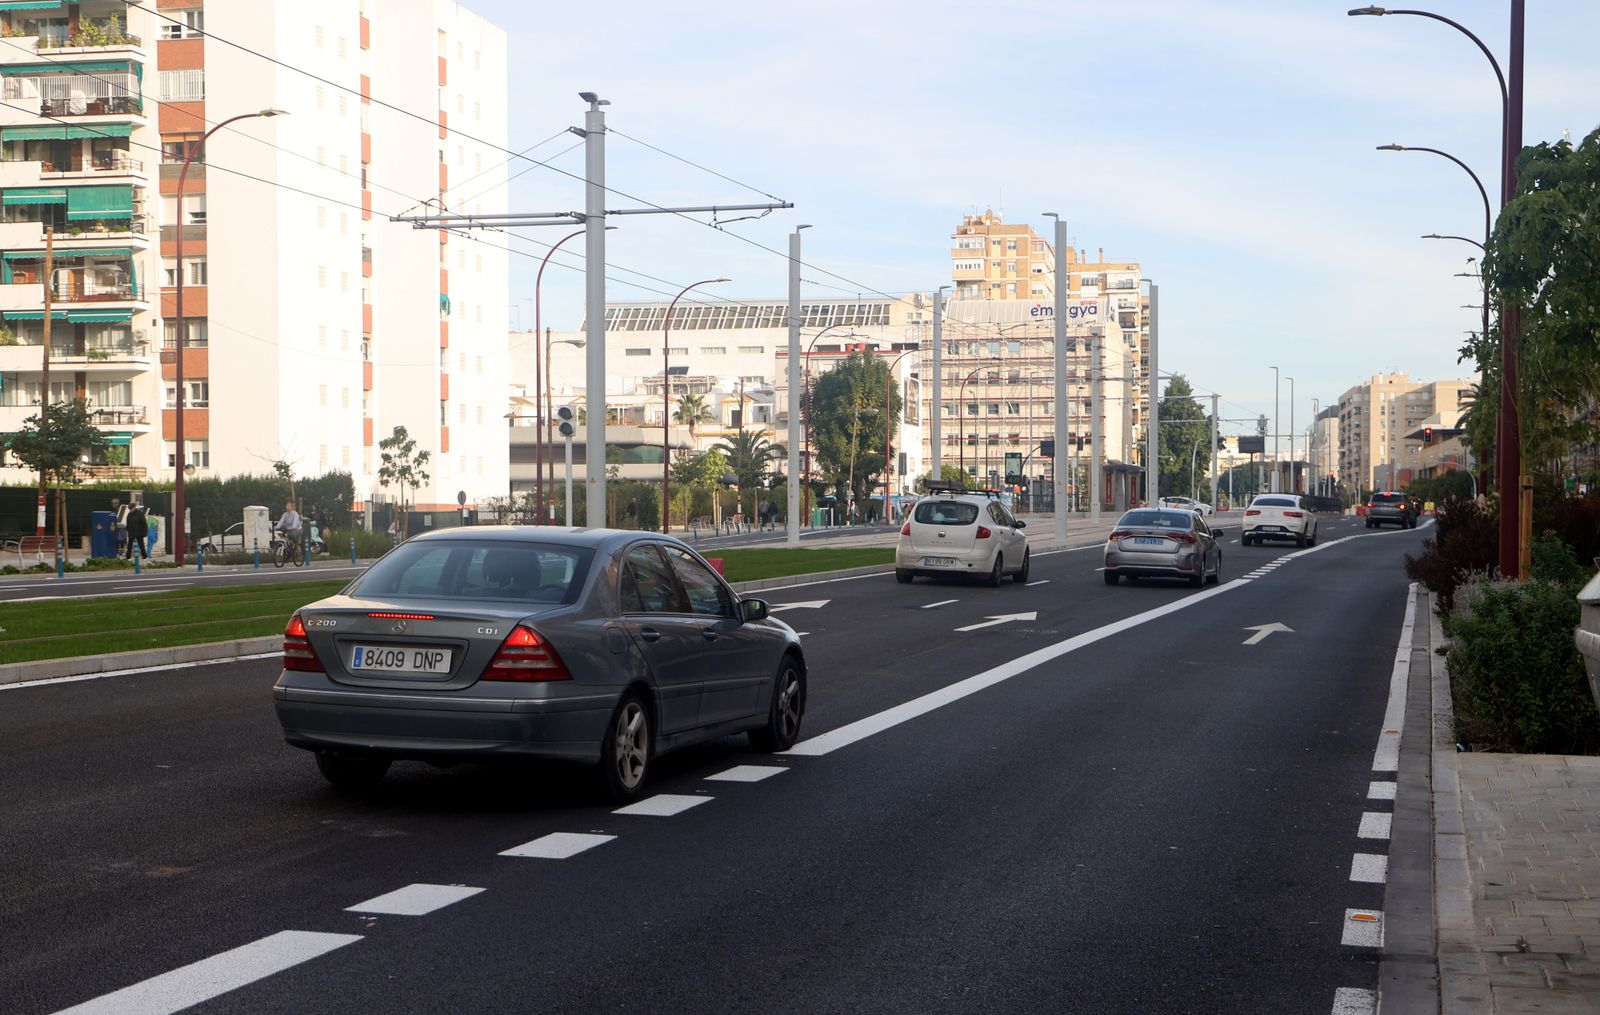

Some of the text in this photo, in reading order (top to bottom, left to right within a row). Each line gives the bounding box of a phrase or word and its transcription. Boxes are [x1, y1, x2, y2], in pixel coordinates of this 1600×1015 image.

[1030, 304, 1098, 318] emgya
[477, 627, 498, 635] CDI
[365, 649, 444, 670] 8409 DNP
